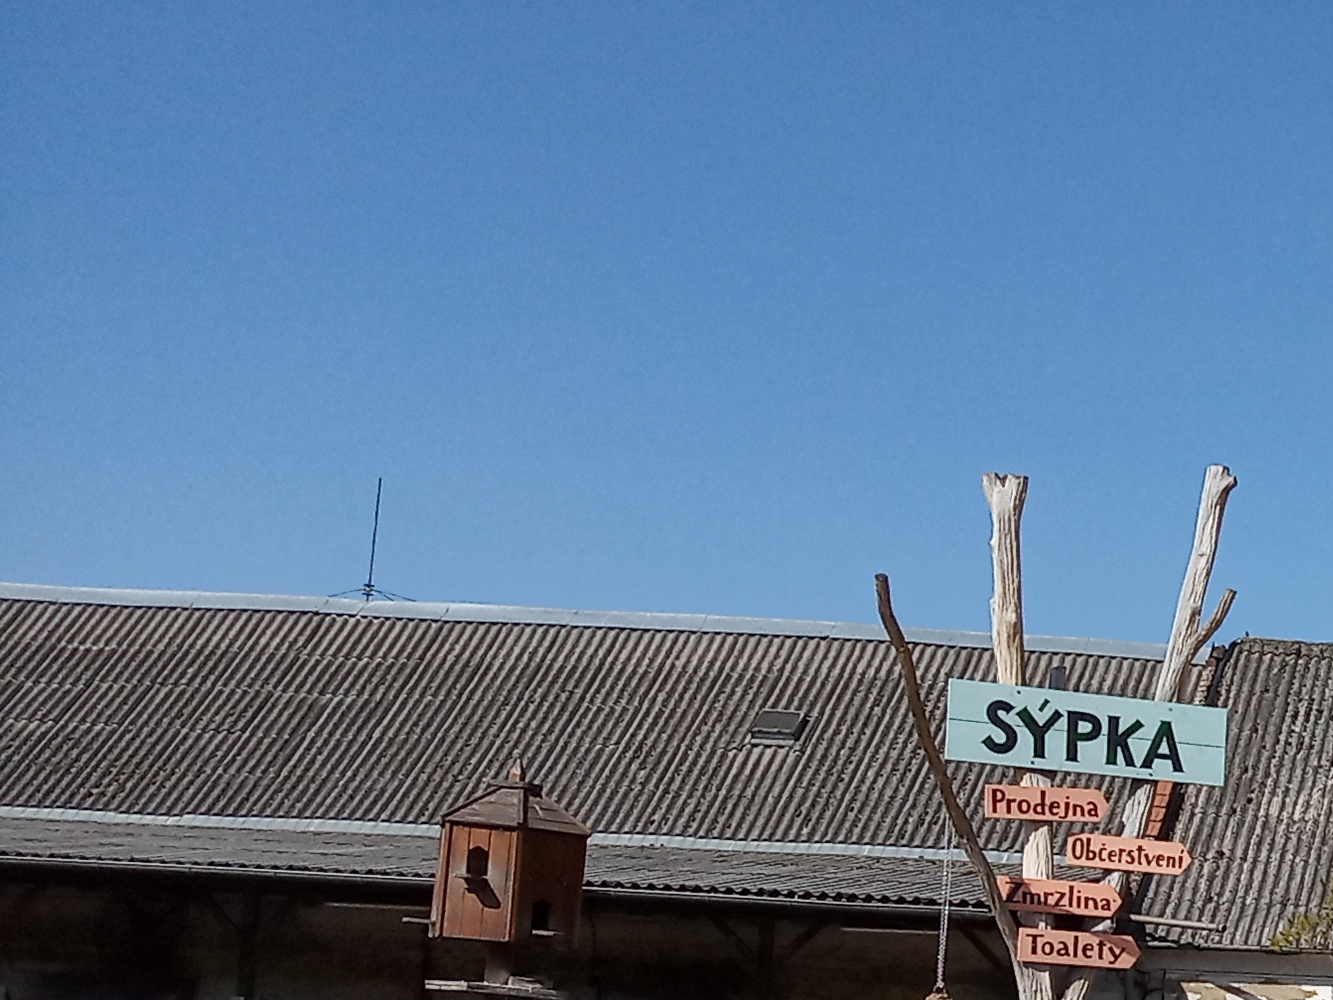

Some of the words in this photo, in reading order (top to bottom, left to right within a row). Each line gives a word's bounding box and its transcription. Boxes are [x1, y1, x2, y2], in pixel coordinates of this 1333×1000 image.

[981, 698, 1186, 774] SÝPKA
[990, 787, 1100, 820] Prodejna
[1070, 836, 1187, 871] Občerstvení
[1004, 880, 1113, 912] Zmrzlina
[1025, 933, 1128, 965] Toalety
